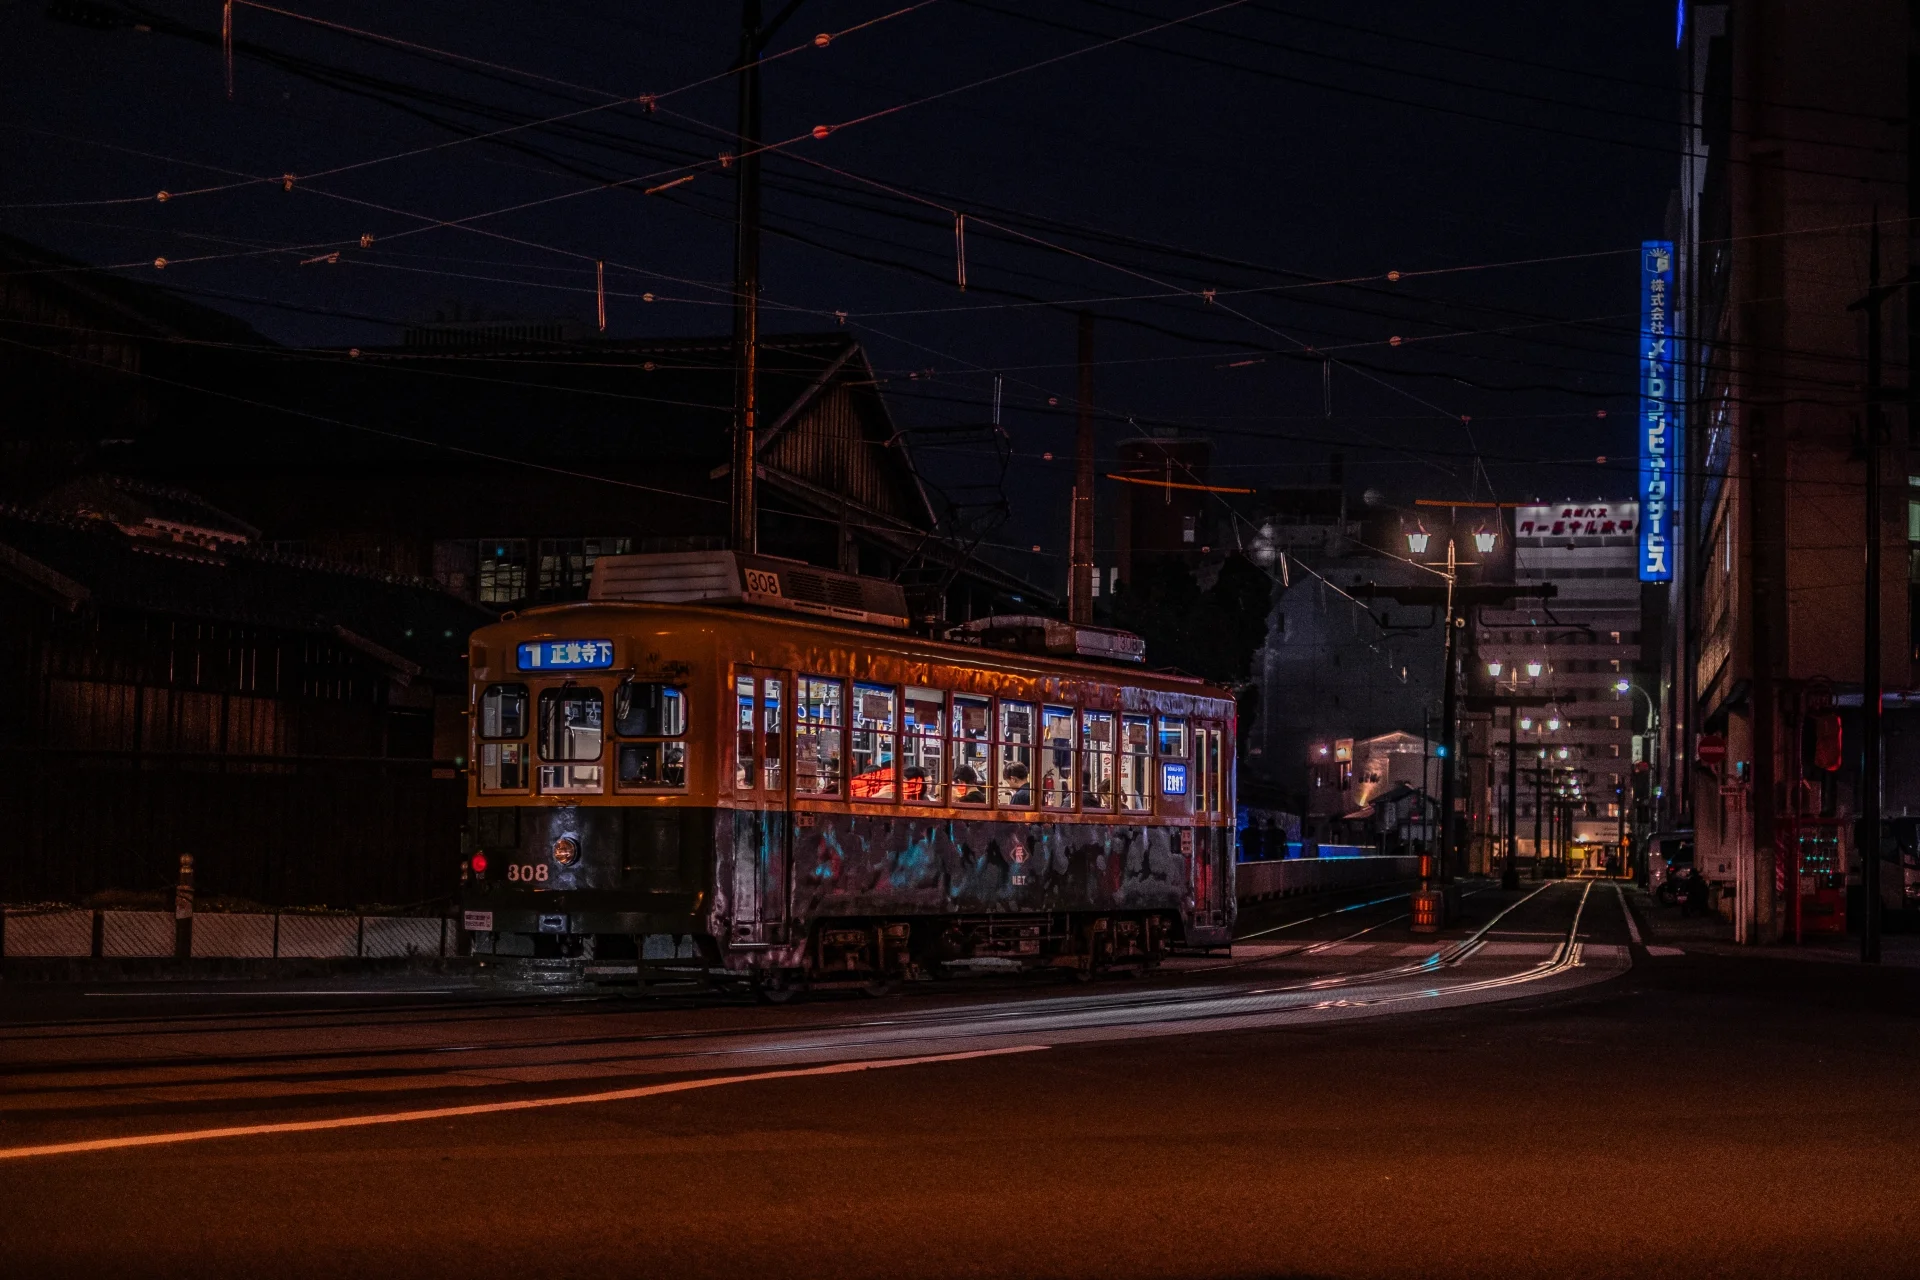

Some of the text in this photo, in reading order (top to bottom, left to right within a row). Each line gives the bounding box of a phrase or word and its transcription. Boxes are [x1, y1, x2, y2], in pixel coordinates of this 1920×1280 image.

[1650, 278, 1665, 335] 株式会社
[1519, 520, 1639, 535] ターミナルホテ
[748, 571, 778, 594] 308
[525, 640, 613, 667] 1 正覚寺下
[1120, 634, 1138, 652] 308
[507, 863, 549, 882] 308
